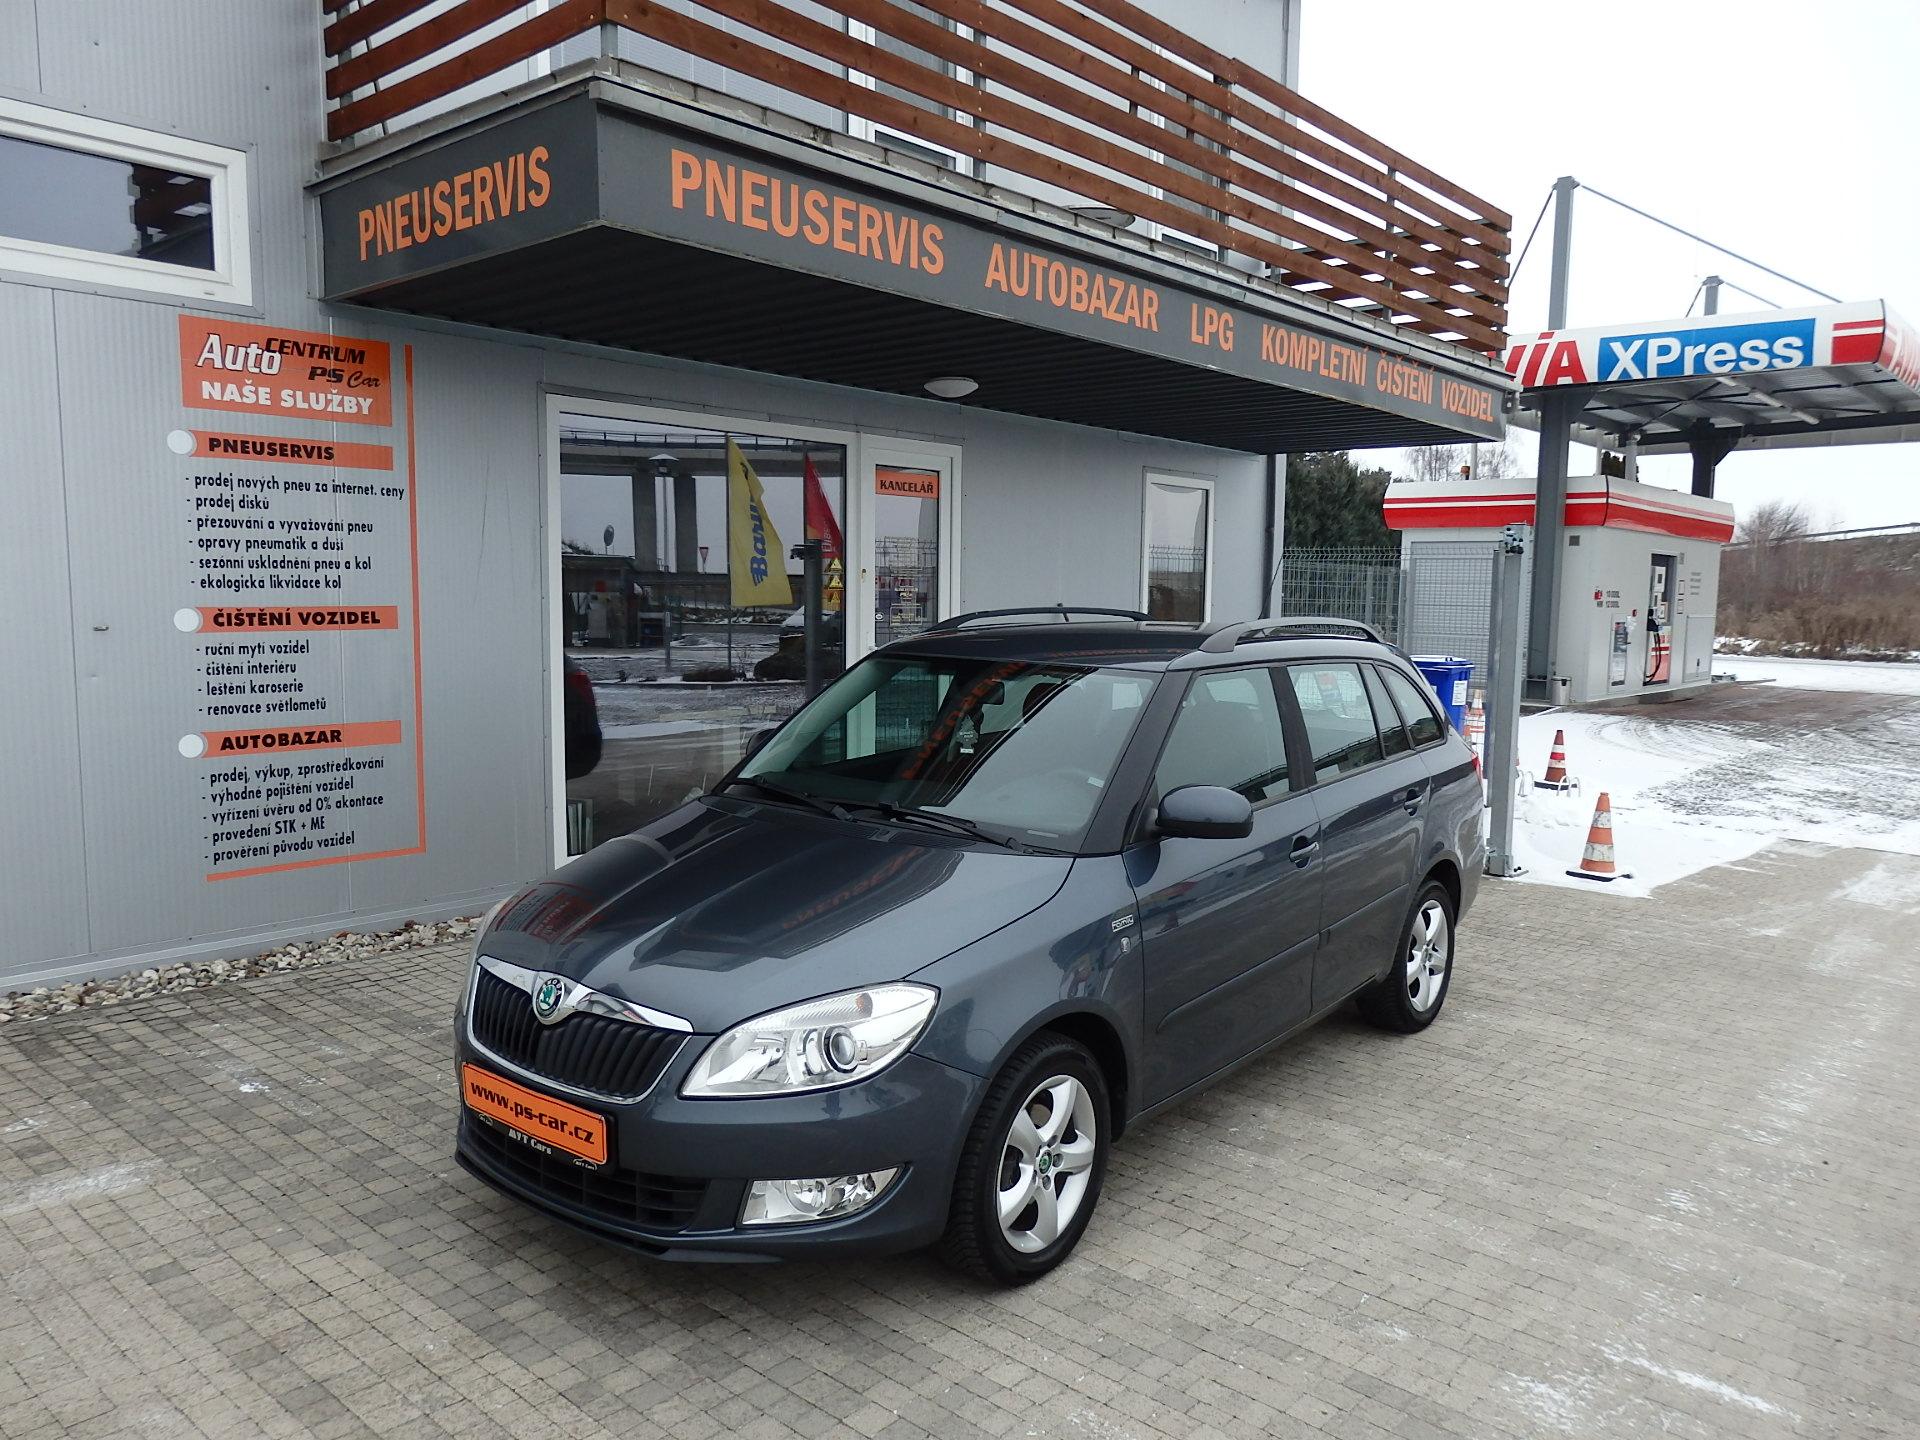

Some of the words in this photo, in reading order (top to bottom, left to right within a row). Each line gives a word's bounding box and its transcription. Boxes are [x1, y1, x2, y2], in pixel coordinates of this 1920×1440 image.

[359, 145, 550, 261] PNEUSERVIS
[671, 149, 944, 275] PNEUSERVIS
[984, 243, 1159, 332] AUTOBAZAR
[1190, 303, 1234, 352] LPG
[1262, 324, 1369, 387] KOMPLETNÍ
[1376, 350, 1435, 405] ČIŠTĚNÍ
[1441, 379, 1494, 422] VOZIDEL
[195, 333, 282, 376] Auto
[265, 338, 366, 364] CENTRUM
[1608, 336, 1804, 380] XPress
[308, 367, 343, 383] PS
[347, 371, 380, 388] Car
[202, 379, 271, 406] NAŠE
[281, 389, 374, 415] SLUŽBY
[208, 438, 334, 460] PNEUSERVIS
[194, 473, 233, 491] prodej
[238, 476, 279, 494] nových
[283, 482, 310, 494] pneu
[316, 482, 328, 493] za
[332, 479, 378, 496] internet.
[380, 486, 404, 500] ceny
[880, 480, 933, 494] KANCELÁŘ
[195, 494, 234, 512] prodej
[239, 495, 269, 510] disků
[197, 515, 263, 531] přezouvání
[268, 520, 275, 529] a
[280, 518, 344, 534] vyvažování
[347, 521, 373, 535] pneu
[198, 537, 241, 551] opravy
[245, 536, 306, 552] pneumatik
[312, 540, 318, 550] a
[199, 556, 244, 569] sezónní
[248, 555, 310, 570] uskladnění
[315, 559, 340, 572] pneu
[345, 560, 350, 570] a
[355, 556, 371, 570] kol
[200, 574, 265, 592] ekologická
[270, 575, 321, 589] likvidace
[324, 575, 342, 589] kol
[213, 608, 291, 627] ČIŠTĚNÍ
[298, 611, 380, 626] VOZIDEL
[205, 642, 234, 656] ruční
[270, 639, 309, 654] vozidel
[206, 661, 244, 676] čištění
[247, 660, 296, 674] interiéru
[207, 681, 246, 696] leštění
[250, 679, 303, 694] karoserie
[208, 703, 261, 715] renovace
[266, 697, 326, 713] světlometů
[220, 730, 342, 751] AUTOBAZAR
[210, 766, 250, 786] prodej,
[255, 763, 293, 782] výkup,
[298, 756, 384, 777] zprostředkování
[211, 786, 261, 806] výhodné
[266, 781, 312, 800] pojištění
[316, 776, 354, 793] vozidel
[212, 806, 259, 826] vyřízení
[264, 800, 295, 816] úvěru
[299, 798, 312, 813] od
[316, 797, 331, 811] 0%
[336, 794, 384, 809] akontace
[213, 824, 271, 846] provedení
[275, 819, 297, 835] STK
[311, 816, 325, 830] ME
[213, 844, 269, 865] prověření
[274, 839, 313, 857] původu
[318, 831, 355, 848] vozidel
[471, 1082, 594, 1144] www.ps-car.cz
